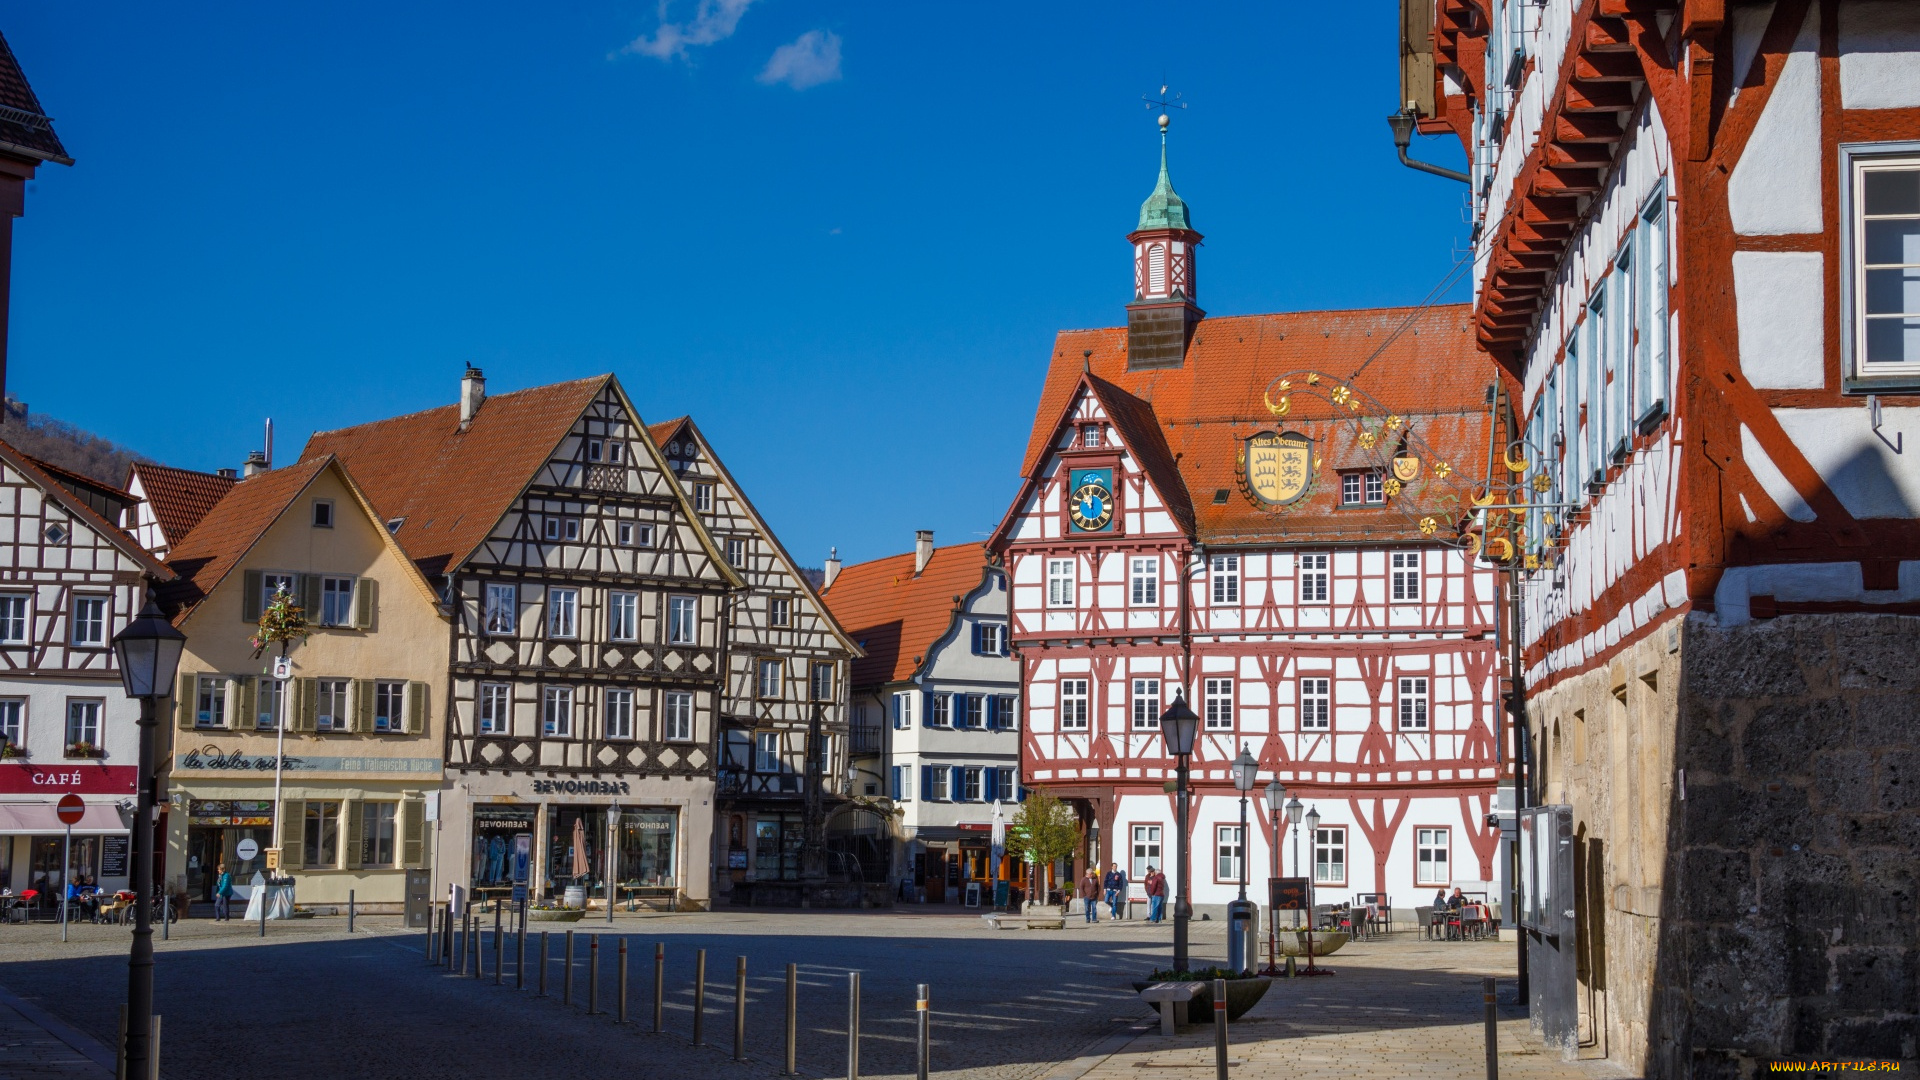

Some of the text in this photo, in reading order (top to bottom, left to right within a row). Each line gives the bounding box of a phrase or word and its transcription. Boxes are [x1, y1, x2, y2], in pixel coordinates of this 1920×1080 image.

[1250, 436, 1308, 449] Altes Oberamt
[340, 758, 361, 770] Feine
[32, 770, 81, 785] CAFÉ
[533, 780, 629, 795] BEWOHNBAR
[479, 820, 528, 828] BEWOHNBAR
